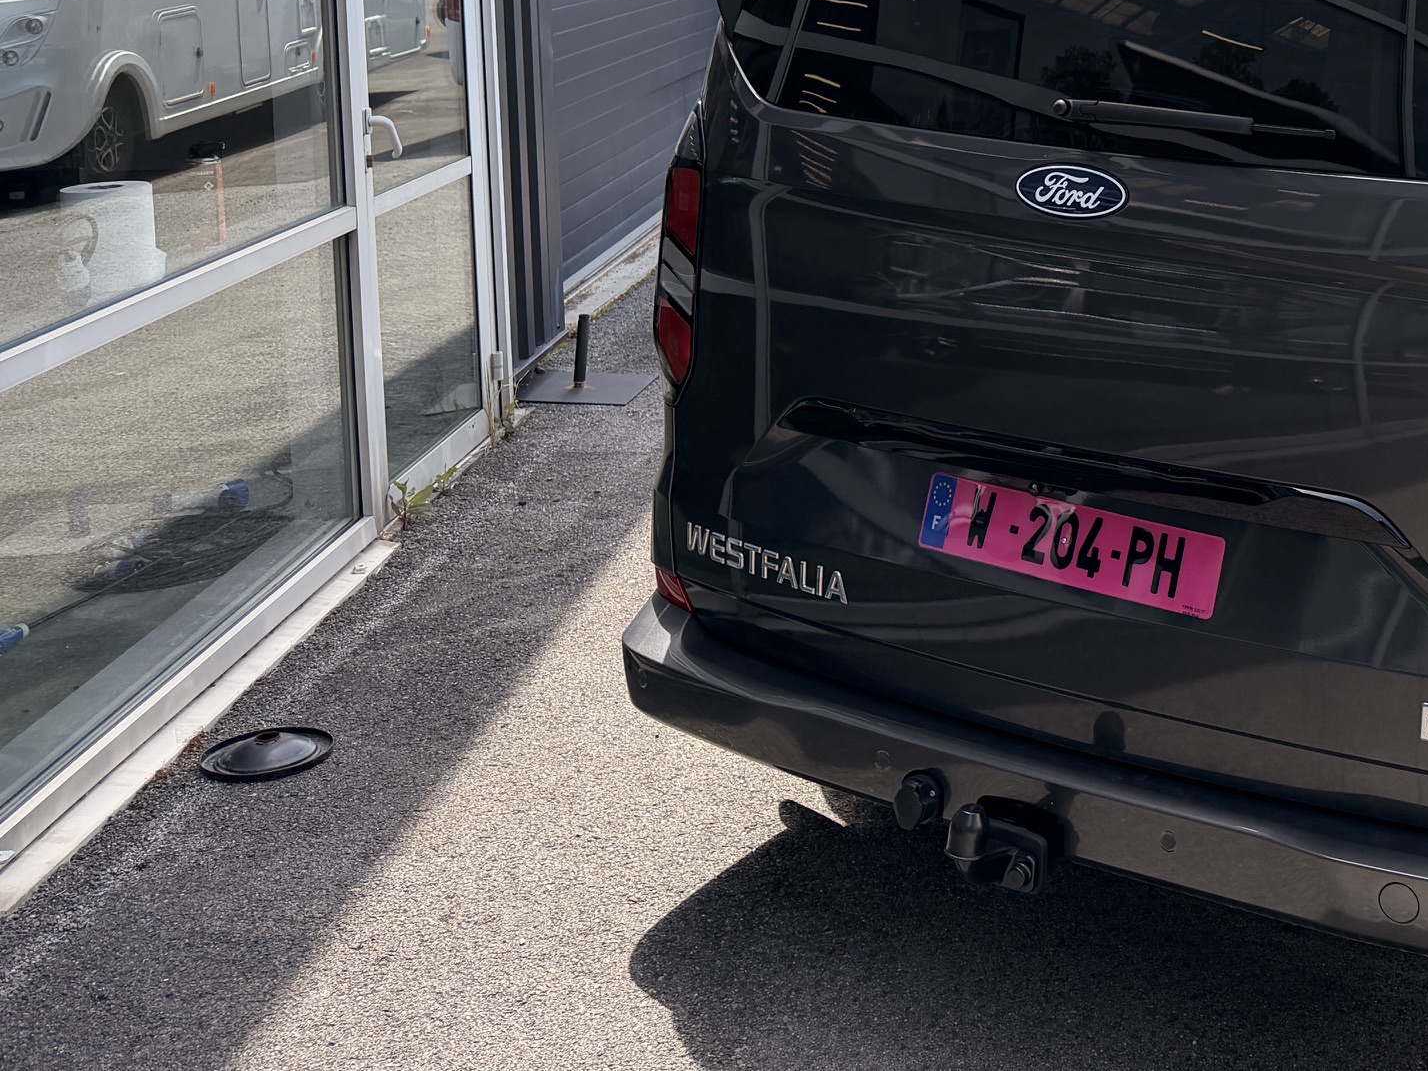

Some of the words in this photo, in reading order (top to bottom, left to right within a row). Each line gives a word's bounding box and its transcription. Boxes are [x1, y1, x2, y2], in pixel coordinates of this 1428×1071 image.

[1035, 171, 1104, 210] Ford
[931, 514, 942, 531] F
[686, 521, 848, 605] WESTFALIA
